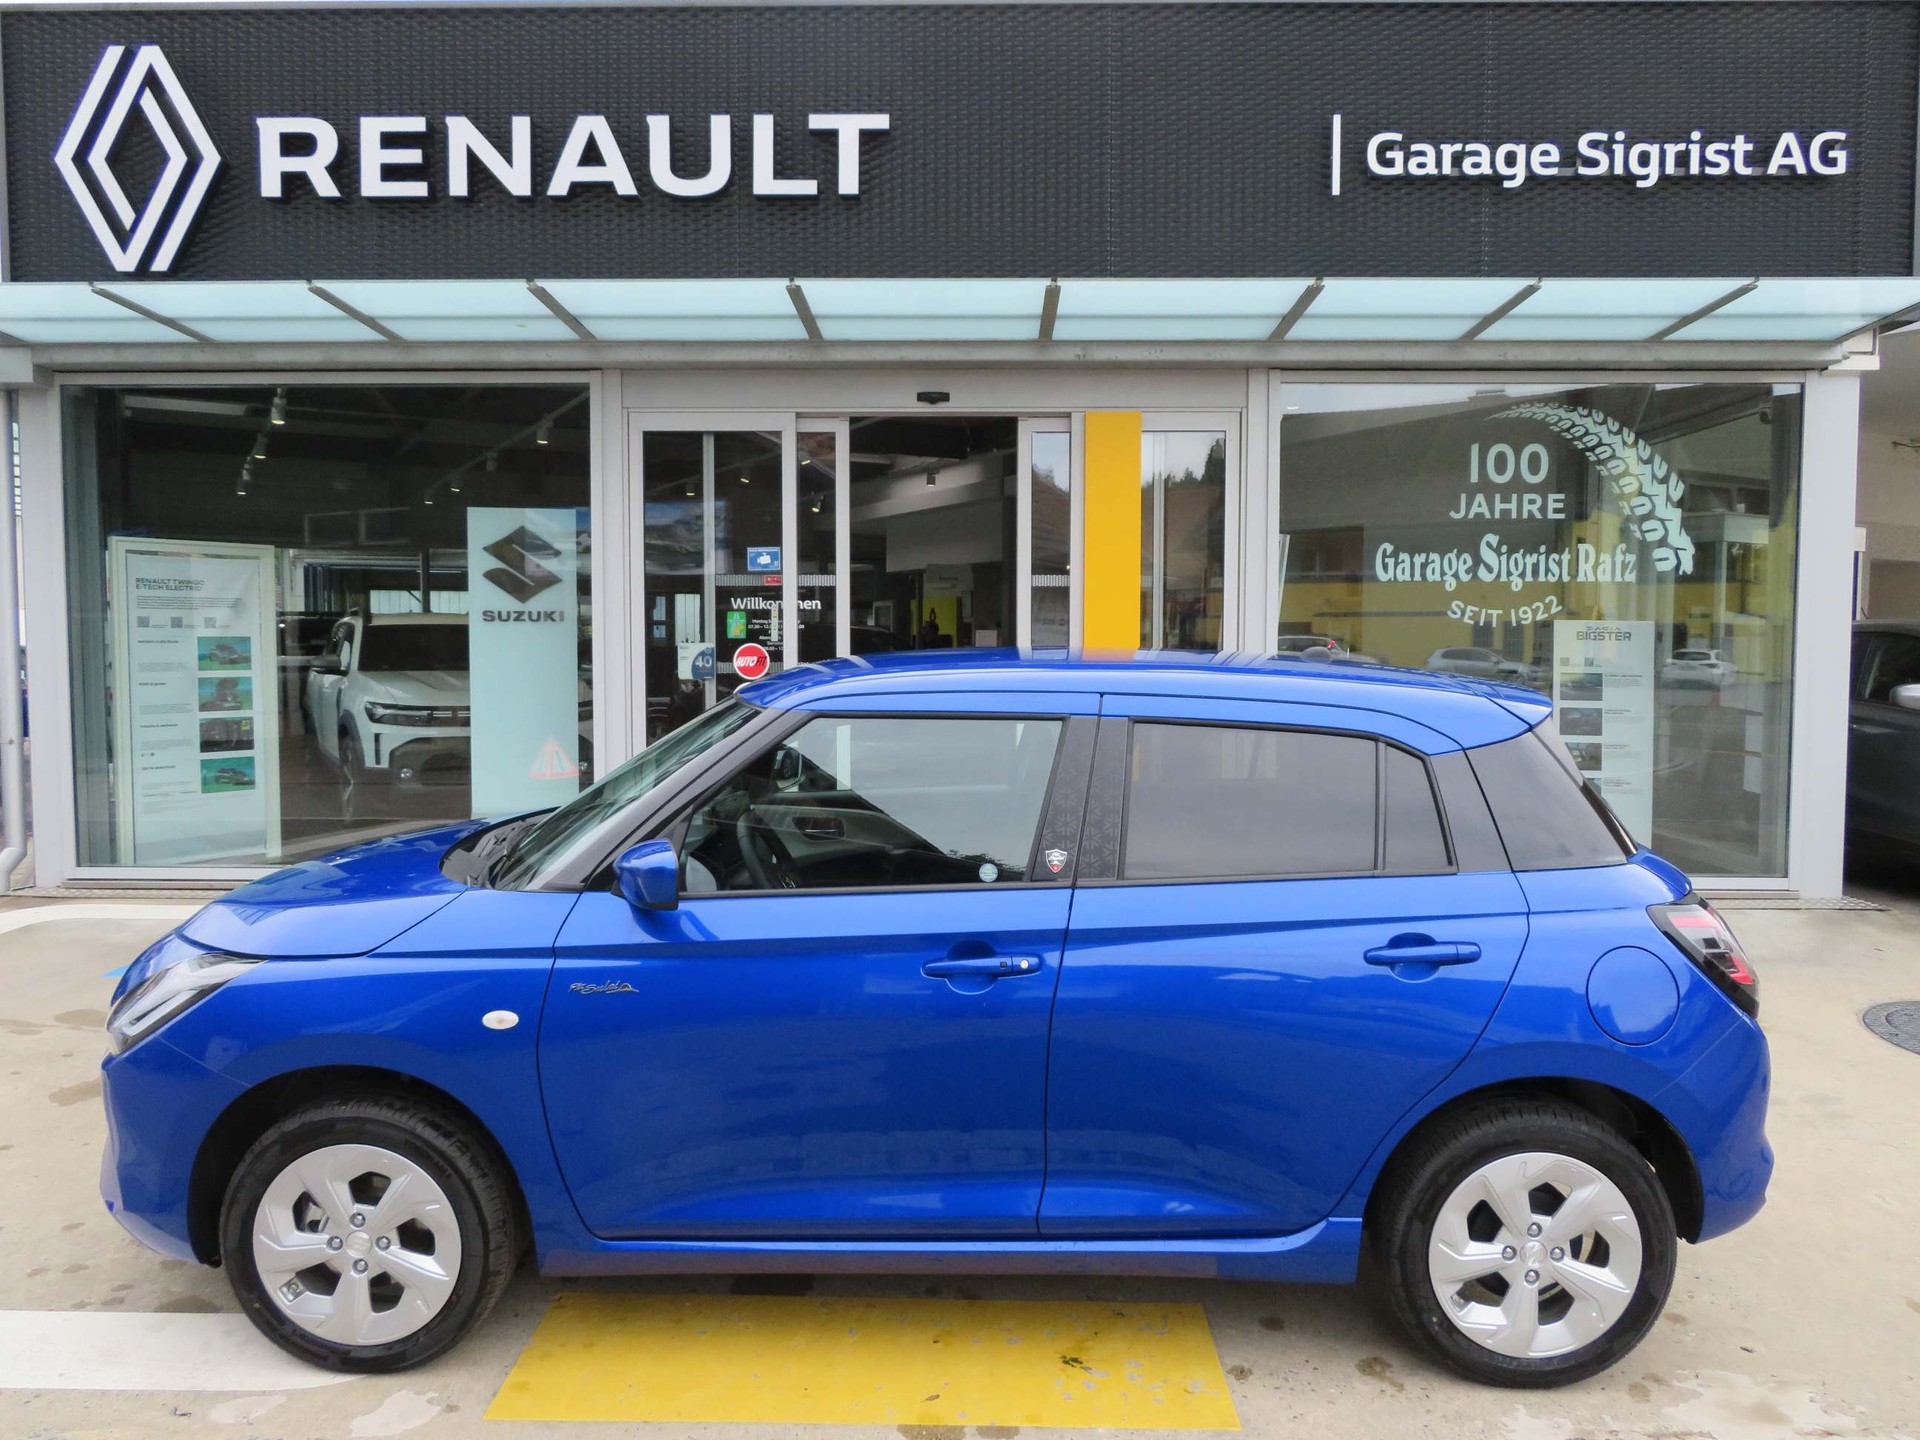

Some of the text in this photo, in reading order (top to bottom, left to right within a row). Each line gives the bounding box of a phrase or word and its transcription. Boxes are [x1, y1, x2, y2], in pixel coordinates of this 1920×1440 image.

[255, 113, 891, 198] RENAULT
[1366, 130, 1848, 188] Garage Sigrist AG
[1468, 442, 1550, 484] 100
[1449, 493, 1567, 520] JAHRE
[1375, 533, 1637, 592] Garage Sigrist Rafz
[135, 577, 172, 585] RENAULT
[482, 609, 565, 622] SUZUKI
[1447, 595, 1564, 628] SEIT 1922
[1576, 631, 1632, 641] BIGSTER
[695, 655, 712, 667] 40
